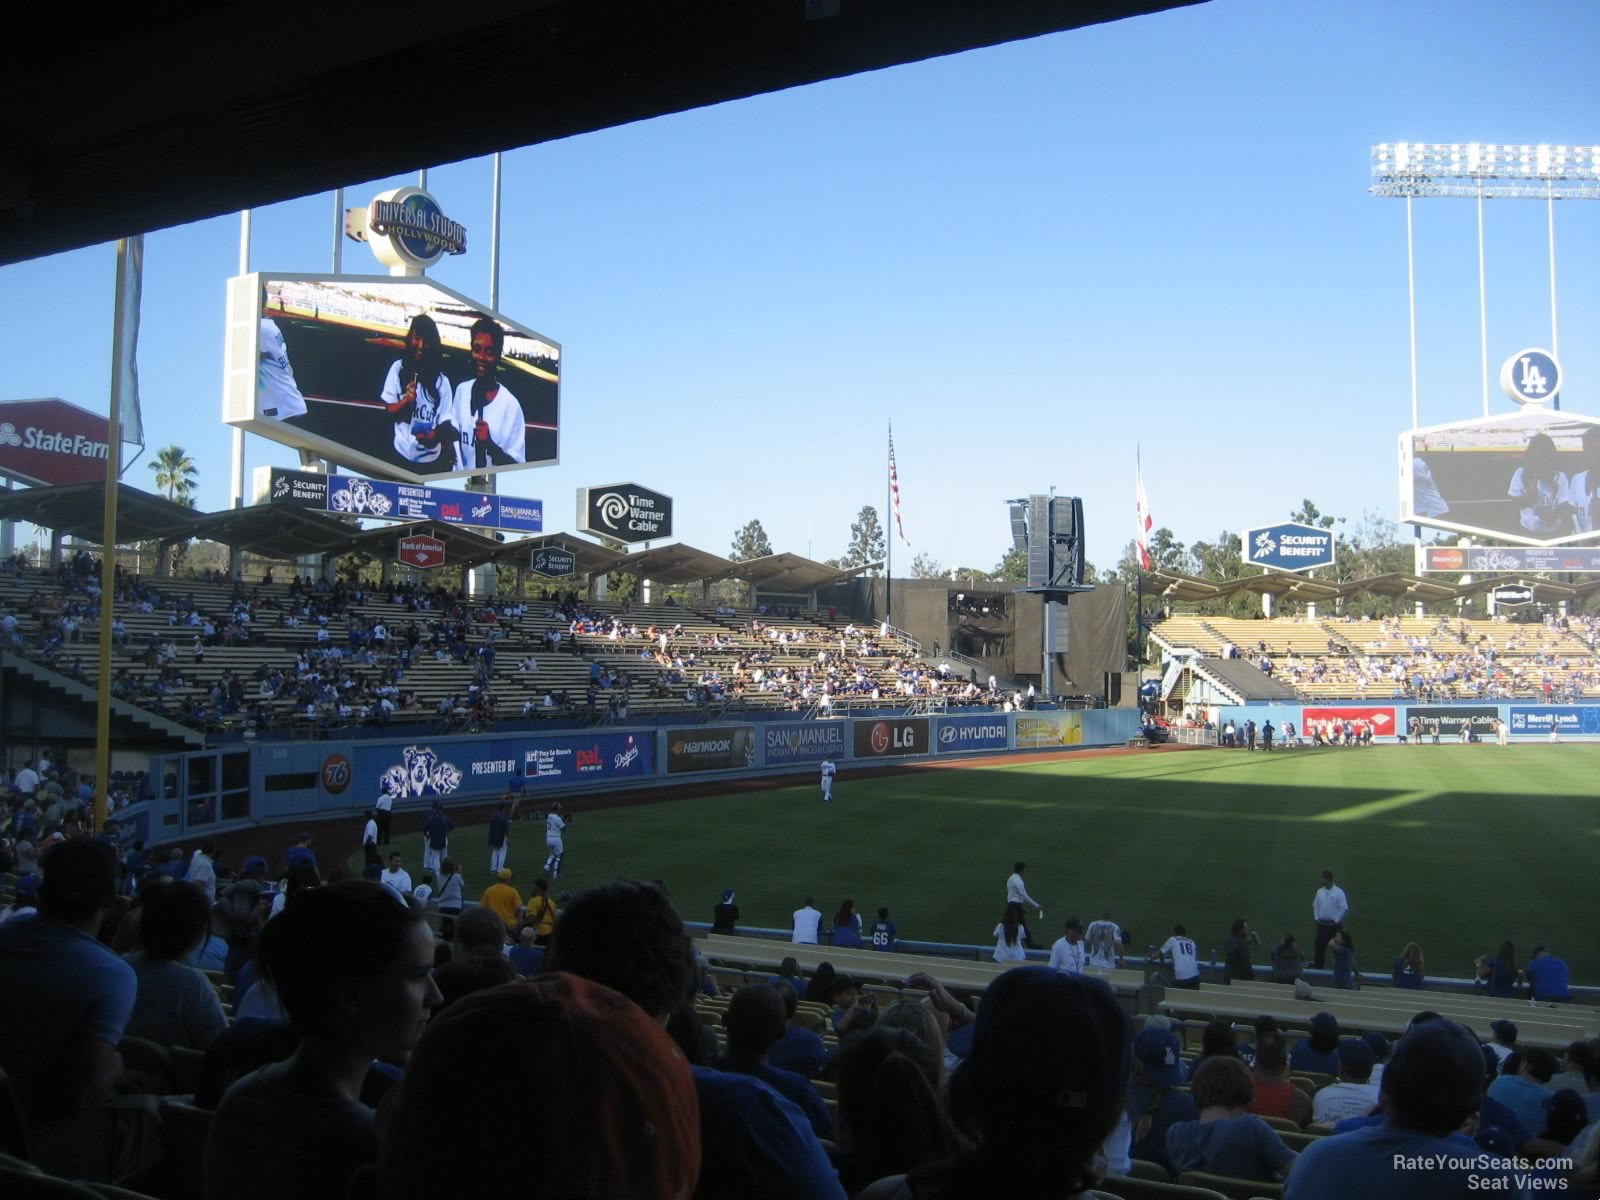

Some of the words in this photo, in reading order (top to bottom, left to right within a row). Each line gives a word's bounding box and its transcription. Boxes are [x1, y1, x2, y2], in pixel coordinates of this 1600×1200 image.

[376, 201, 428, 230] UNIVERSAL
[388, 225, 456, 251] HOLLYWOOD
[1520, 357, 1548, 393] LA
[293, 480, 327, 491] SECURITY
[425, 489, 432, 499] BY
[629, 494, 654, 508] Time
[500, 505, 512, 513] SAN
[517, 507, 541, 517] MANUEL
[630, 507, 664, 520] Warner
[628, 519, 658, 532] Cable
[402, 542, 415, 550] Bank
[421, 543, 442, 551] America
[1280, 535, 1328, 545] SECURITY
[548, 556, 572, 564] SECURITY
[1419, 716, 1440, 725] Time
[1527, 713, 1553, 723] Merrill
[1555, 713, 1578, 724] Lynch
[767, 730, 791, 748] SAN
[799, 728, 842, 745] MANUEL
[893, 726, 914, 748] LG
[960, 726, 1006, 740] HYUNDAI
[768, 747, 790, 757] INDIAN
[823, 743, 843, 753] CASINO
[614, 746, 639, 768] Dodgers
[327, 761, 348, 785] 76
[472, 761, 507, 775] PRESENTED
[507, 760, 516, 772] BY
[873, 931, 888, 945] 66
